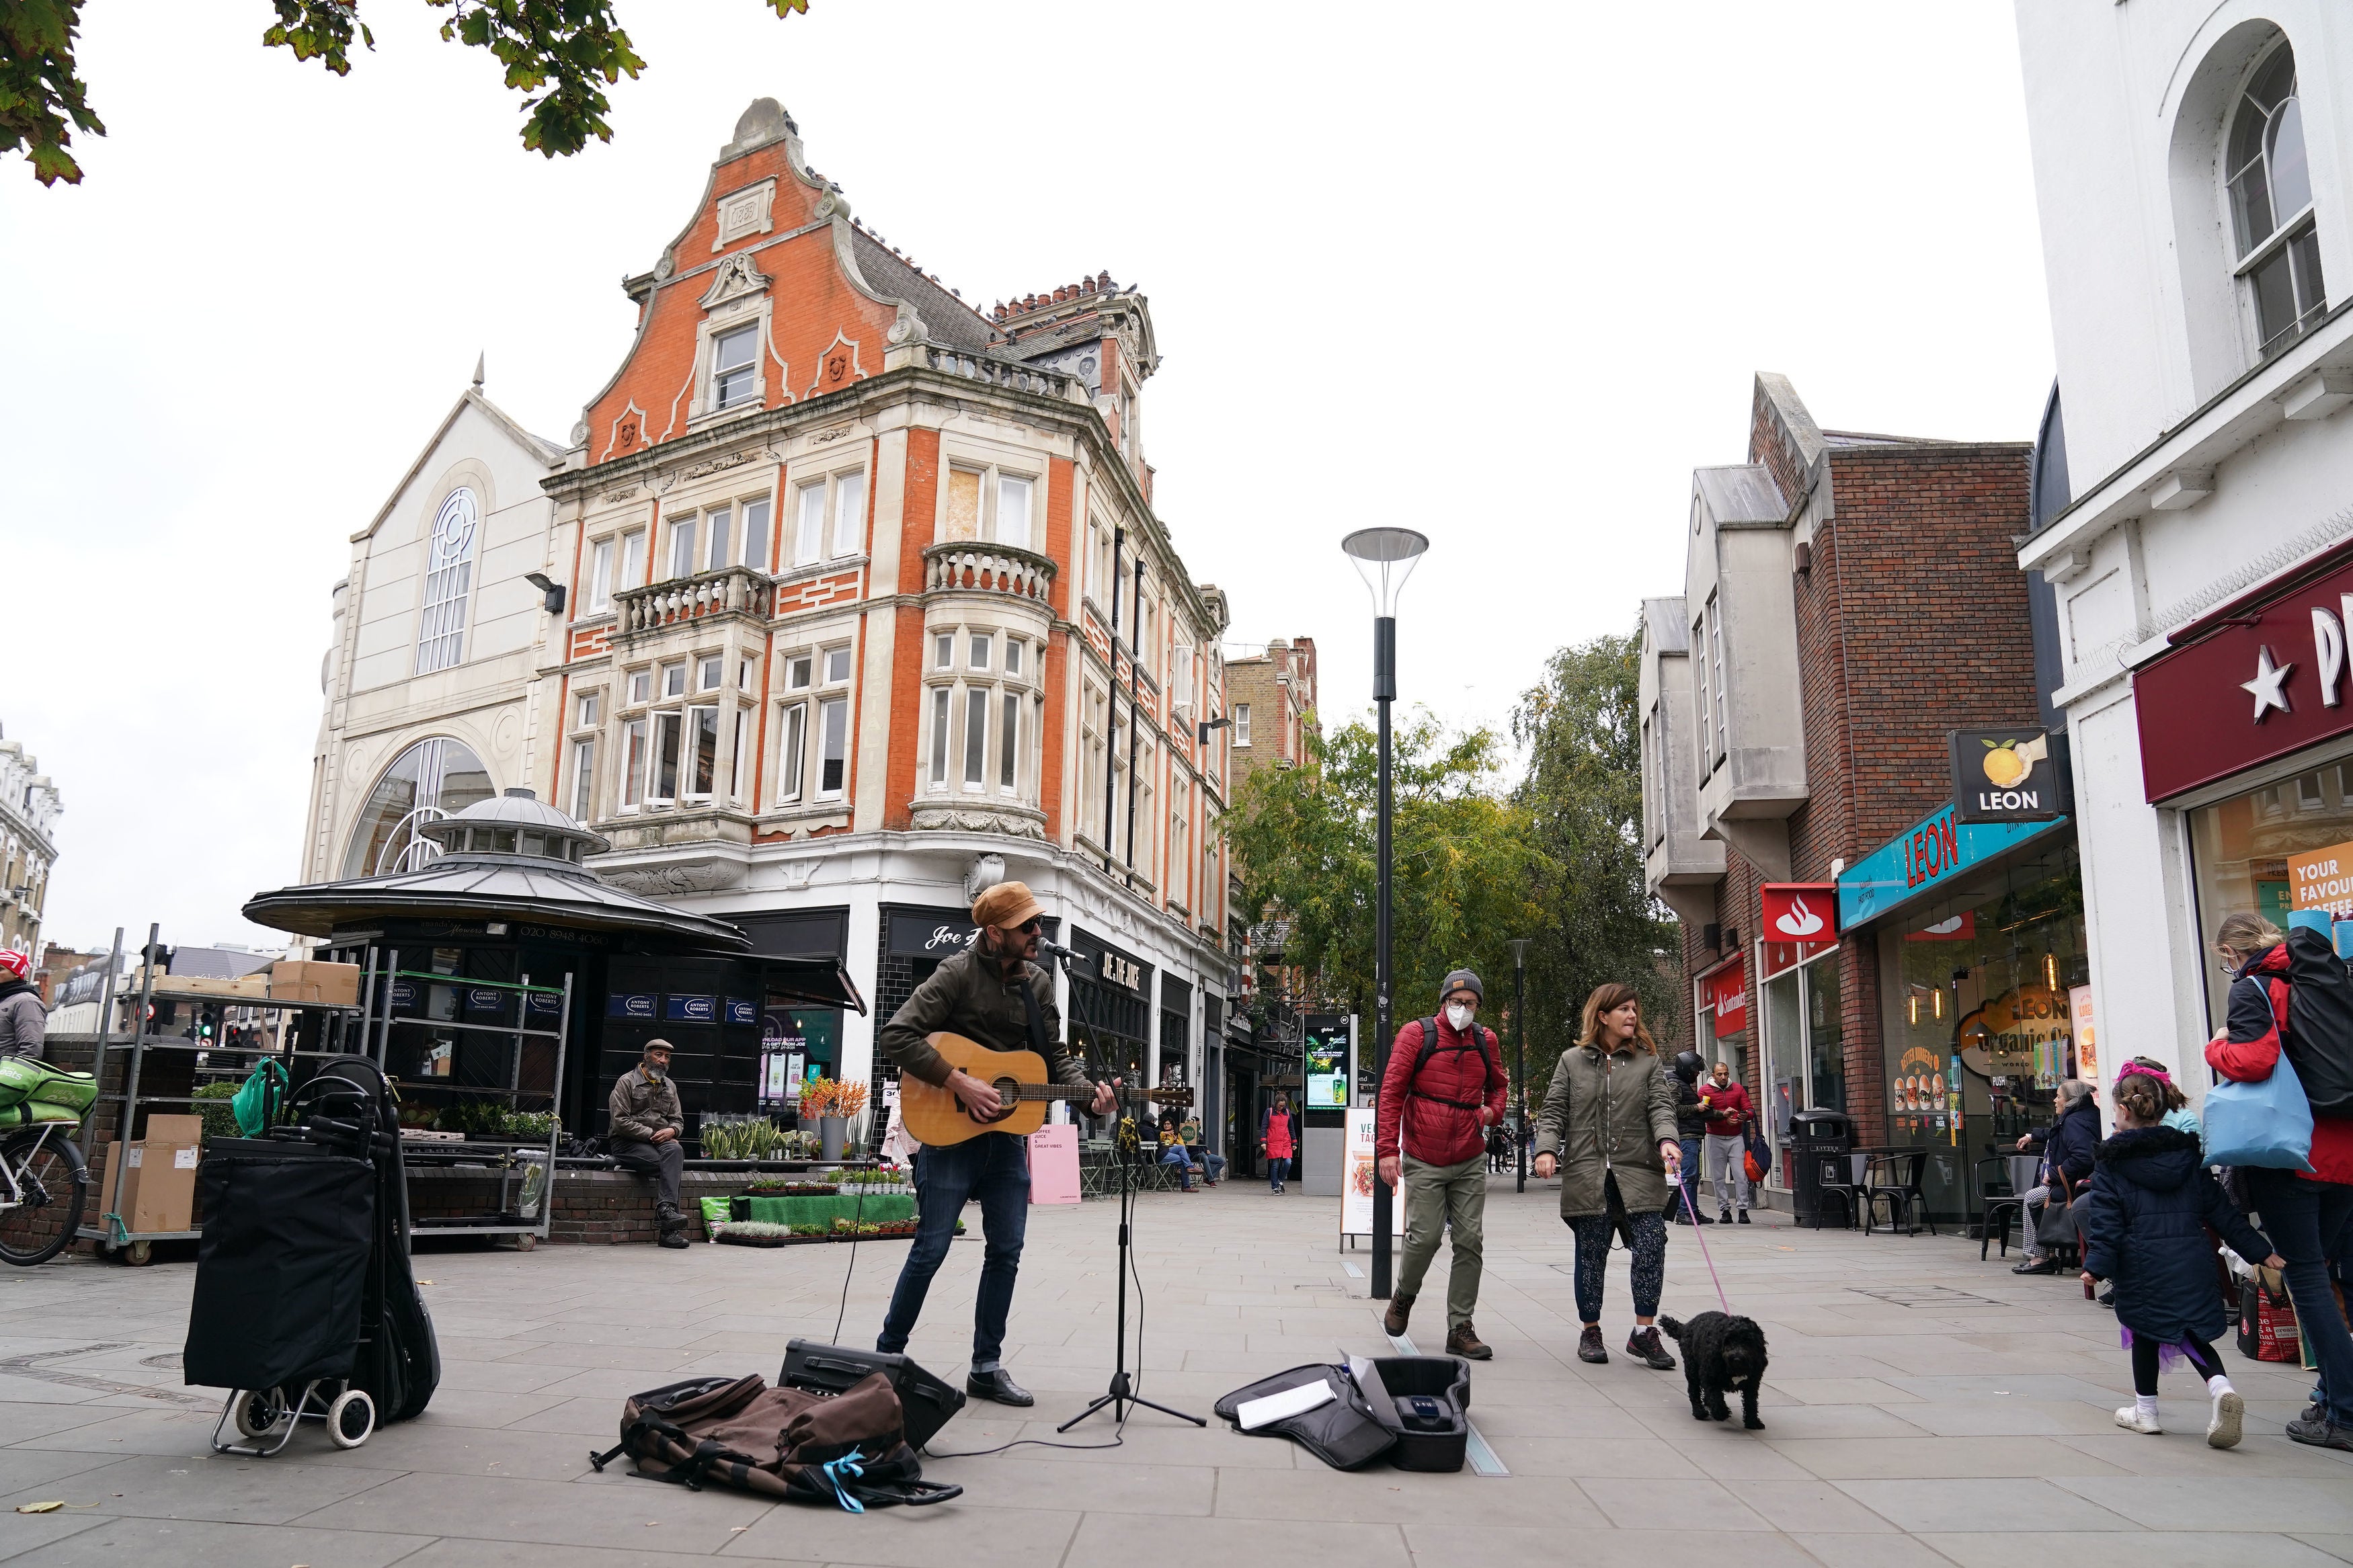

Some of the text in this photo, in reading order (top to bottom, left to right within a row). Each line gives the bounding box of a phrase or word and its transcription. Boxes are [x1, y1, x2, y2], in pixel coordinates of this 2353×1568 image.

[1979, 791, 2038, 811] LEON
[1905, 811, 1958, 889] LEON
[2297, 859, 2339, 882] YOUR
[451, 924, 484, 936] flowers
[520, 927, 545, 937] 020
[549, 930, 575, 941] 8948
[925, 925, 961, 950] Joe
[1103, 951, 1113, 980] JOE
[1115, 956, 1125, 985] THE
[1125, 961, 1140, 991] JUICE
[1724, 985, 1746, 1014] Santander
[2012, 998, 2068, 1020] LEON
[1993, 1076, 2005, 1086] PUSH
[42, 1093, 83, 1106] eats
